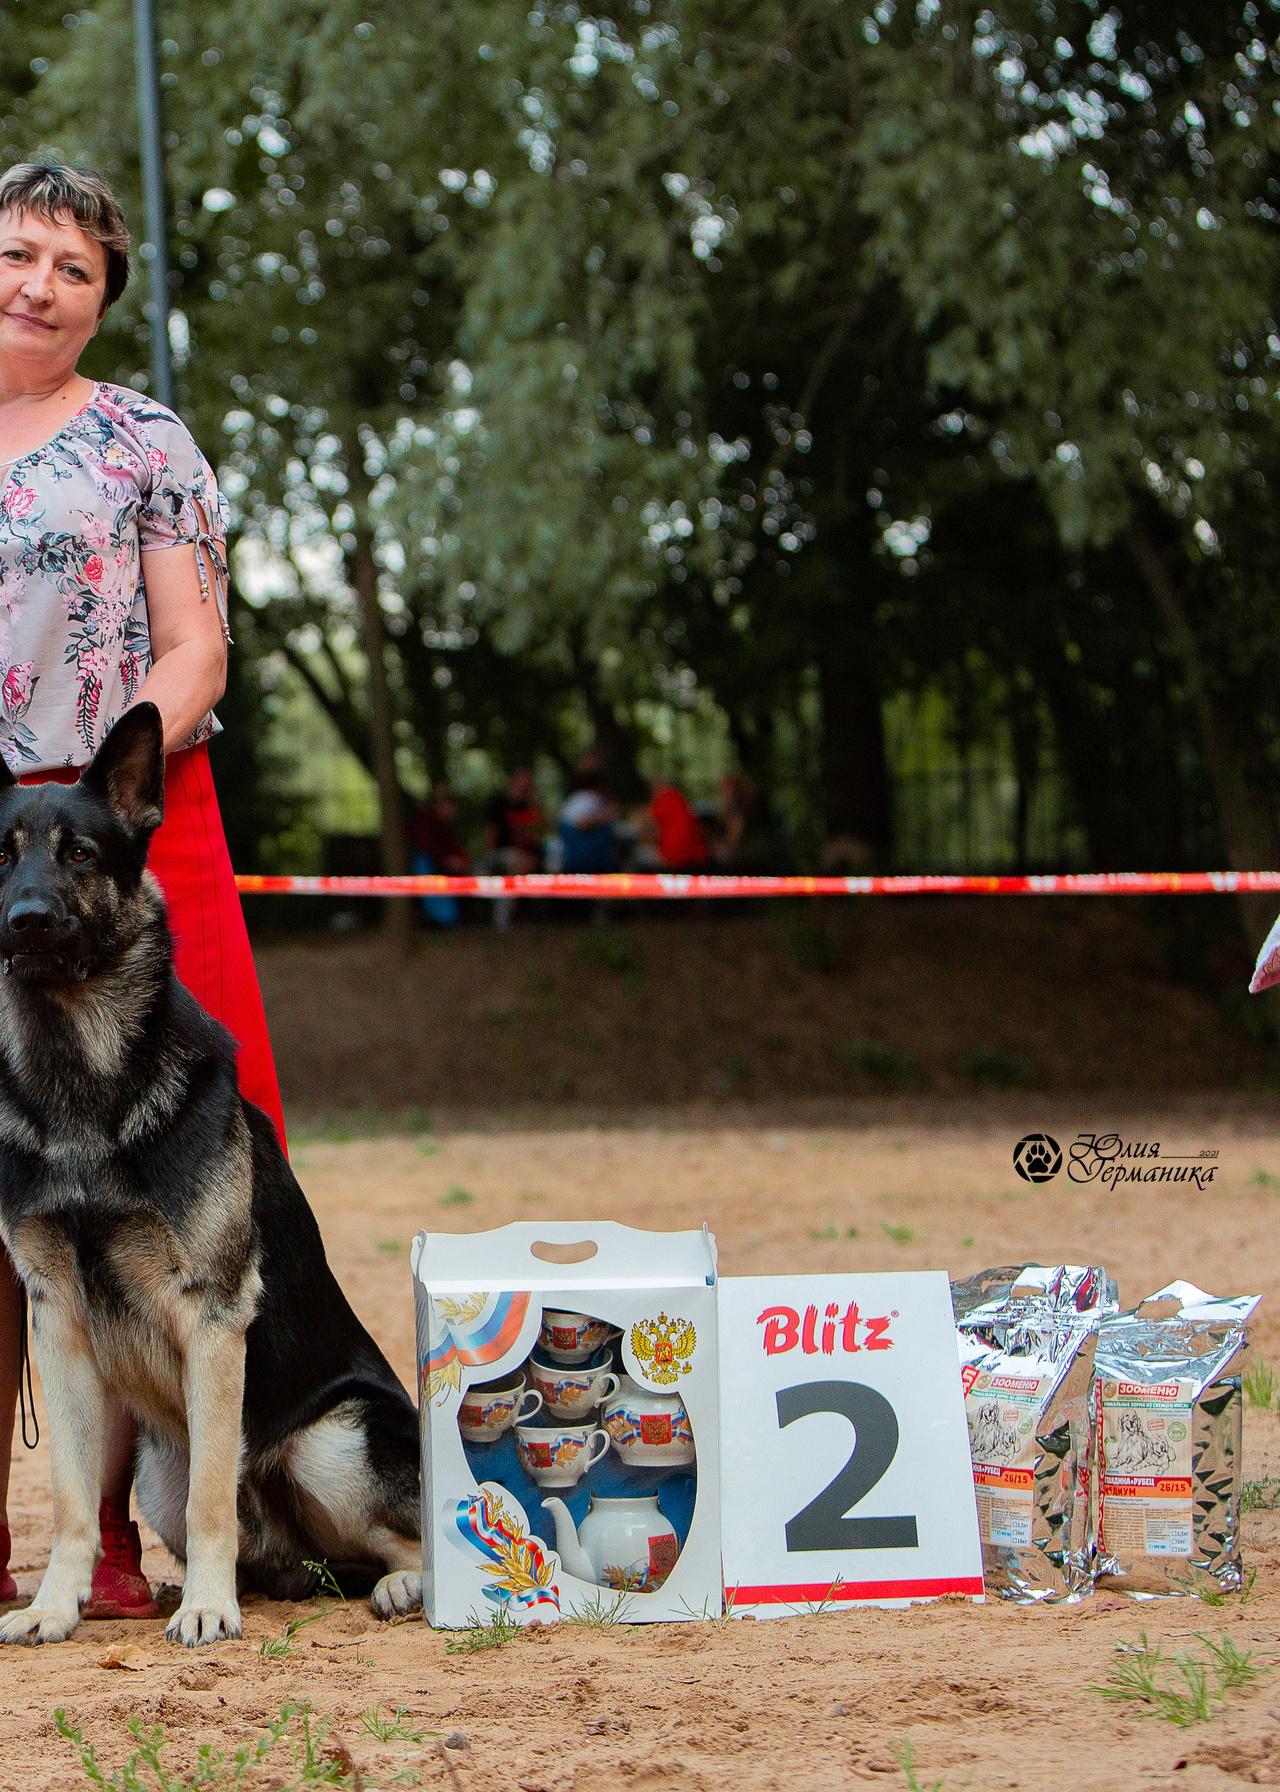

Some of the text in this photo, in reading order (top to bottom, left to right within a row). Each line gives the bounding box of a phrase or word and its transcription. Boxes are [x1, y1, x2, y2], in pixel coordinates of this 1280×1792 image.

[757, 1300, 895, 1356] Blitz
[993, 1378, 1037, 1390] ЗООМЕНЮ
[1119, 1384, 1178, 1396] ЗООМЕНЮ
[776, 1380, 919, 1552] 2
[1004, 1474, 1028, 1483] 26/15
[1160, 1483, 1186, 1492] 26/15
